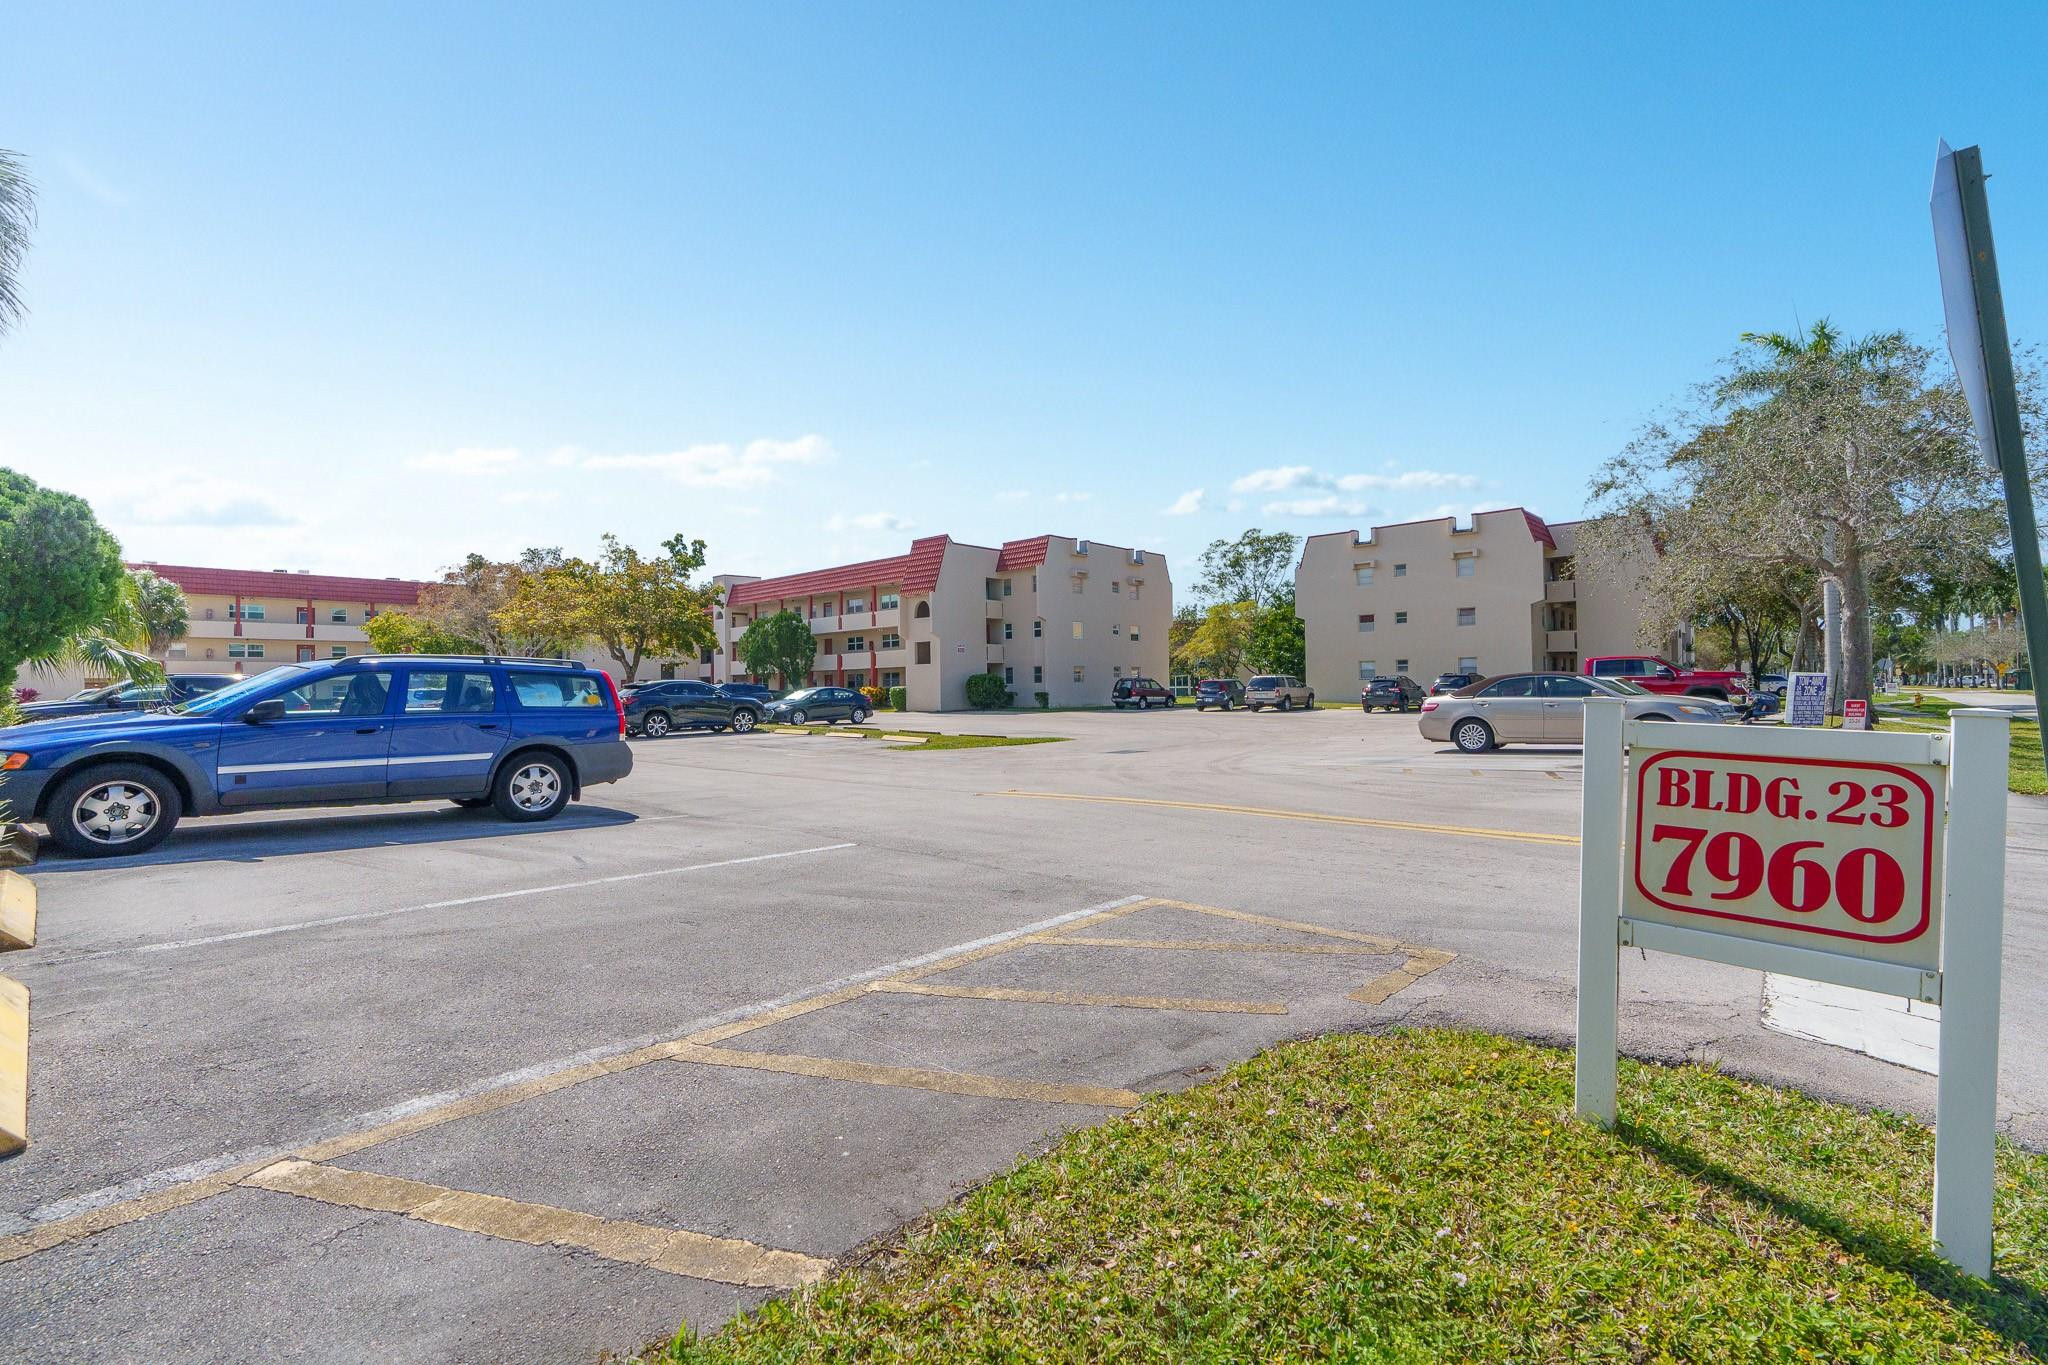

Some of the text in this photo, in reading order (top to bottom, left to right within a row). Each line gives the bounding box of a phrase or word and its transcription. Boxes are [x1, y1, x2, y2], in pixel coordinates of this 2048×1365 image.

[1803, 685, 1818, 696] ZONE
[1656, 766, 1910, 828] BLDG. 23
[1651, 824, 1906, 924] 7960
